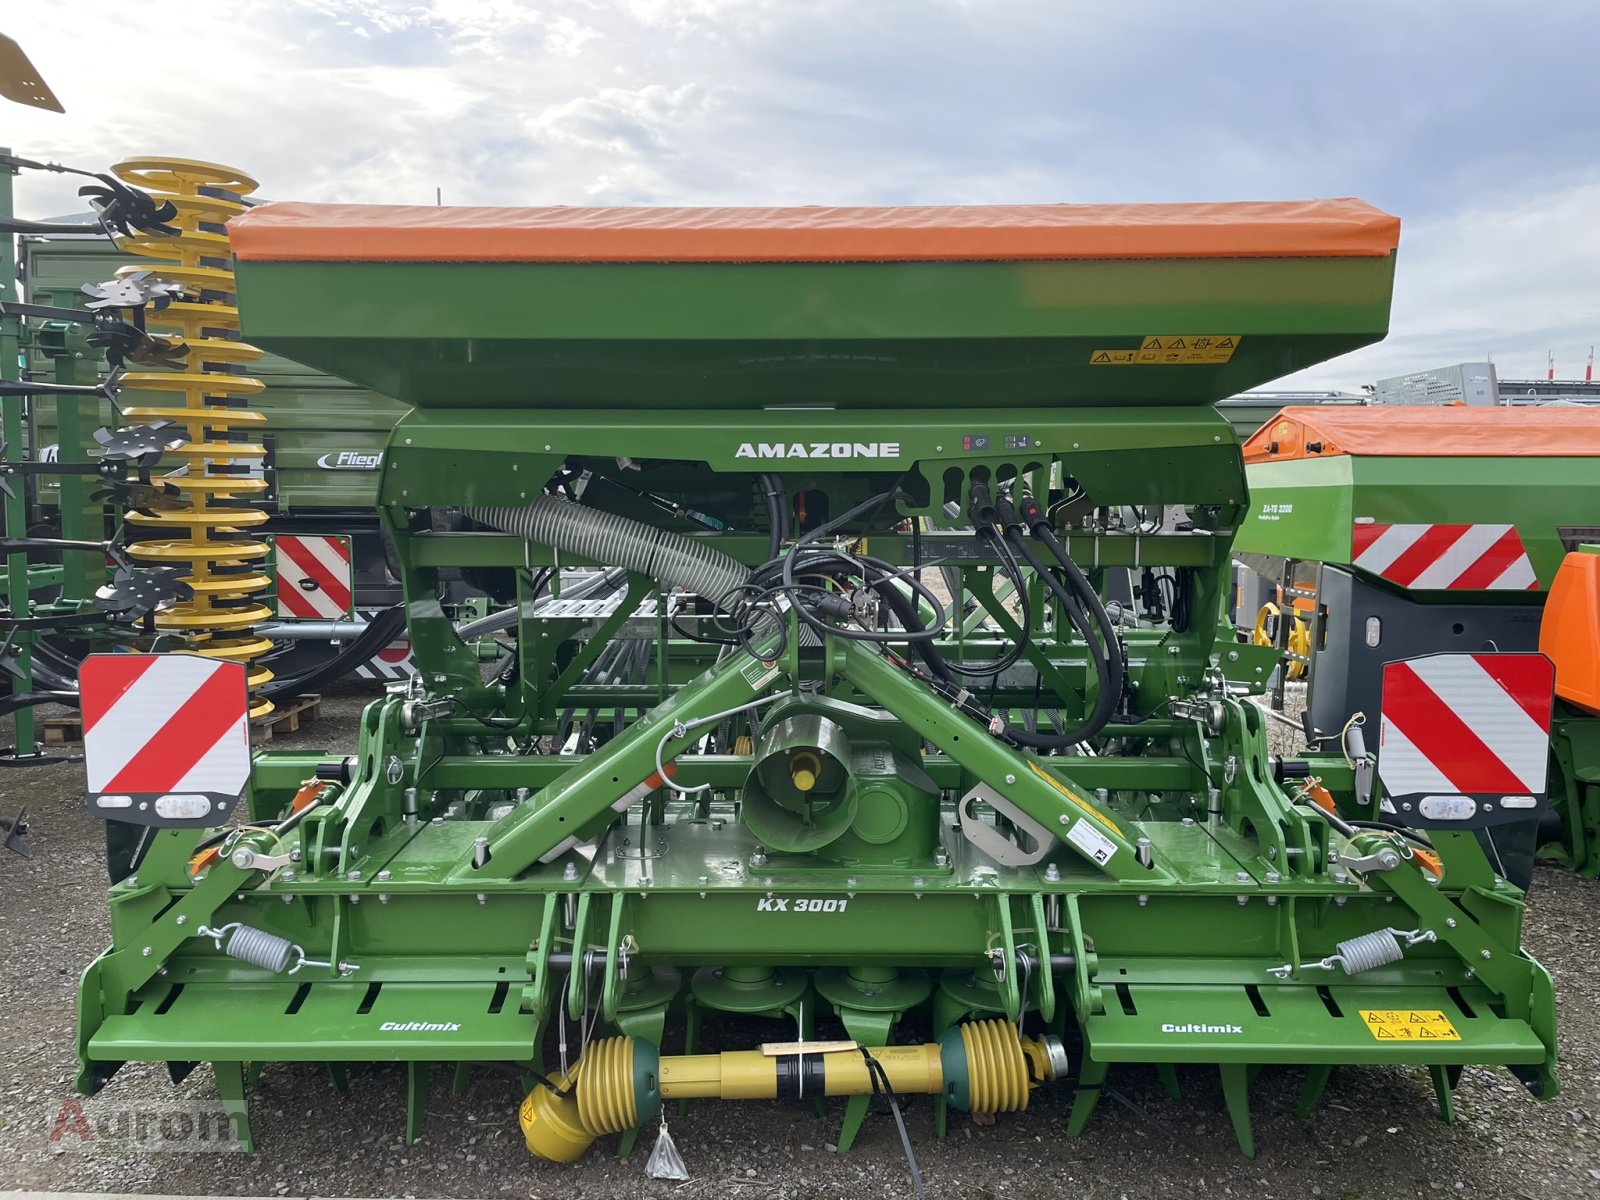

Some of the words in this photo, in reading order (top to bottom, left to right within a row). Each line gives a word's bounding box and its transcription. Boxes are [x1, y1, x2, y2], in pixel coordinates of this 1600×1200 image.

[735, 443, 900, 458] AMAZONE
[336, 452, 384, 468] Fliegl
[757, 898, 790, 912] KX
[793, 899, 848, 912] 3001
[379, 1021, 462, 1031] Cultimix
[1161, 1023, 1243, 1033] Cultimix
